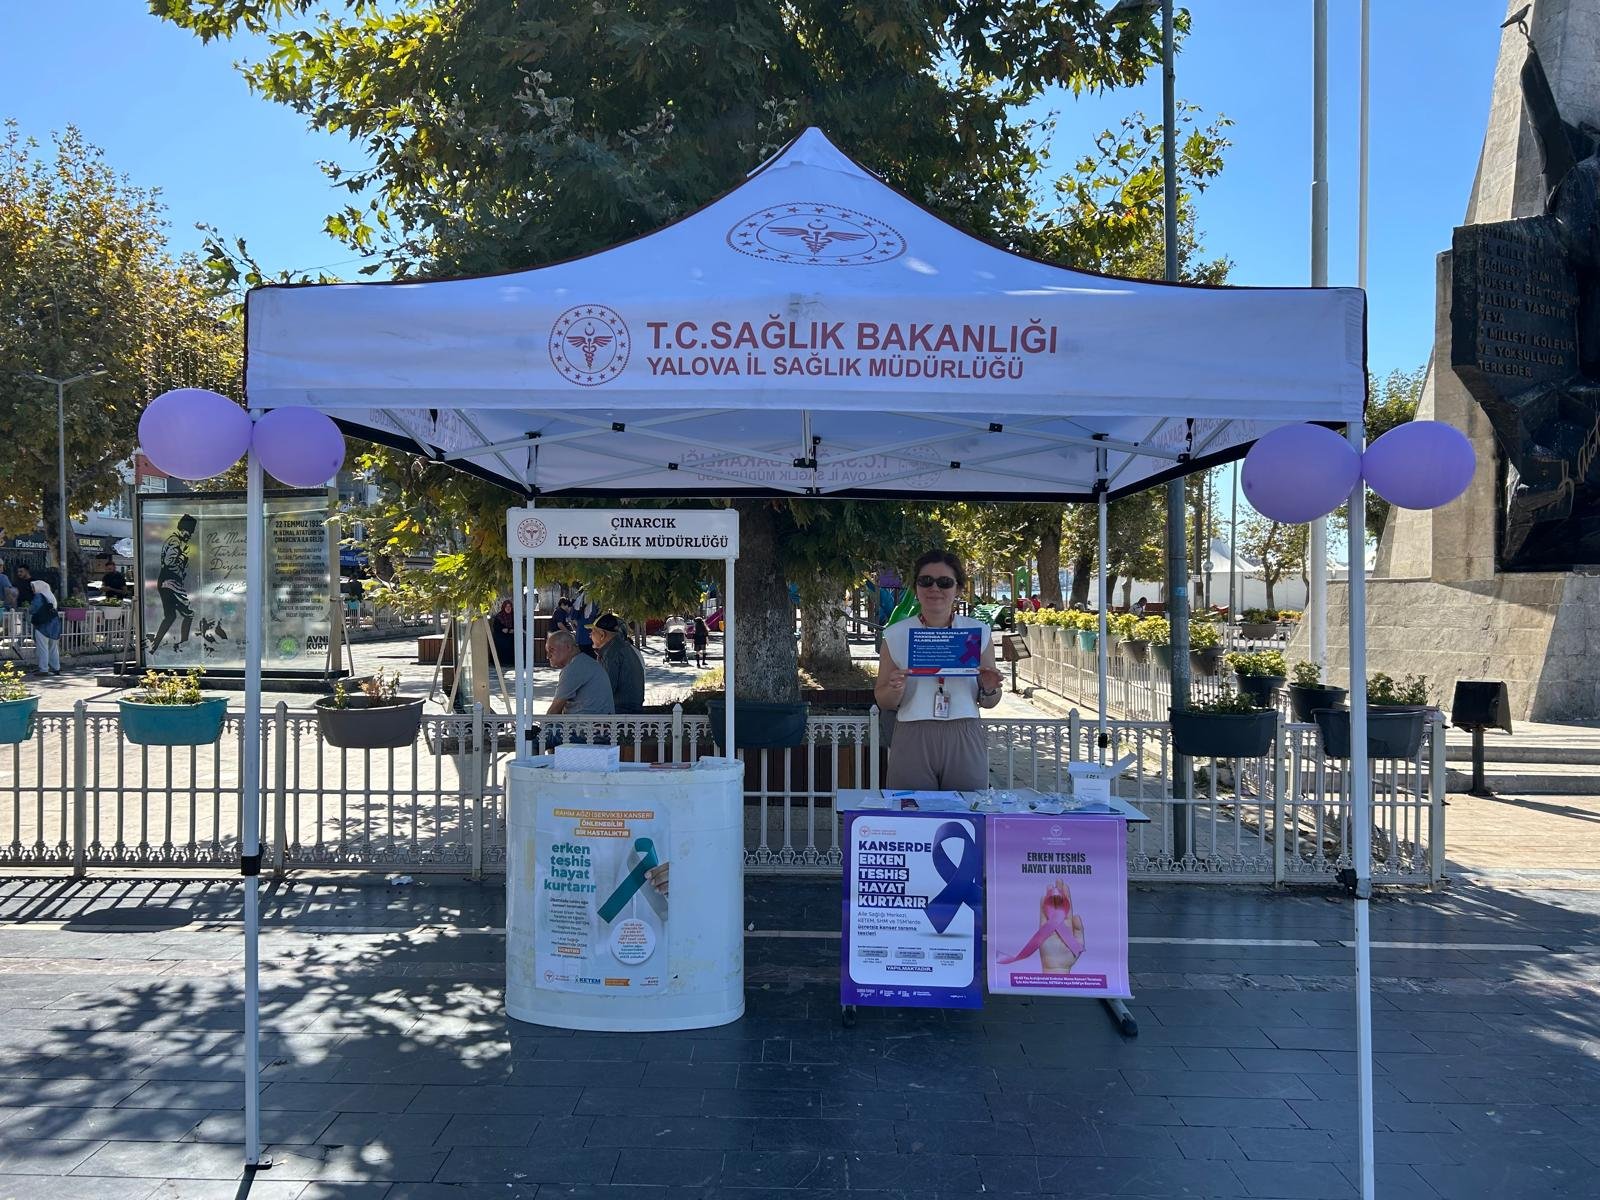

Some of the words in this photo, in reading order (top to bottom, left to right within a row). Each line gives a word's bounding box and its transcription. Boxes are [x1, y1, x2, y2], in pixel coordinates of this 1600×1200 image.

[647, 314, 844, 351] T.C.SAĞLIK
[857, 318, 1058, 354] BAKANLIĞI
[647, 356, 739, 376] YALOVA
[745, 352, 767, 376] İL
[773, 352, 862, 377] SAĞLIK
[868, 353, 1024, 380] MÜDÜRLÜĞÜ
[275, 520, 283, 528] 22
[283, 520, 308, 528] TEMMUZ
[611, 517, 676, 531] ÇINARCIK
[558, 534, 588, 550] İLÇE
[592, 534, 641, 548] SAĞLIK
[645, 534, 729, 549] MÜDÜRLÜĞÜ
[551, 842, 591, 855] erken
[859, 840, 932, 852] KANSERDE
[550, 855, 591, 867] teşhis
[860, 854, 904, 866] ERKEN
[1028, 852, 1054, 862] ERKEN
[1056, 851, 1086, 865] TEŞHİS
[551, 866, 590, 881] hayat
[1021, 863, 1047, 873] HAYAT
[1049, 864, 1092, 875] KURTARIR
[544, 878, 597, 893] kurtarır
[859, 882, 905, 893] HAYAT
[859, 895, 927, 908] KURTARIR
